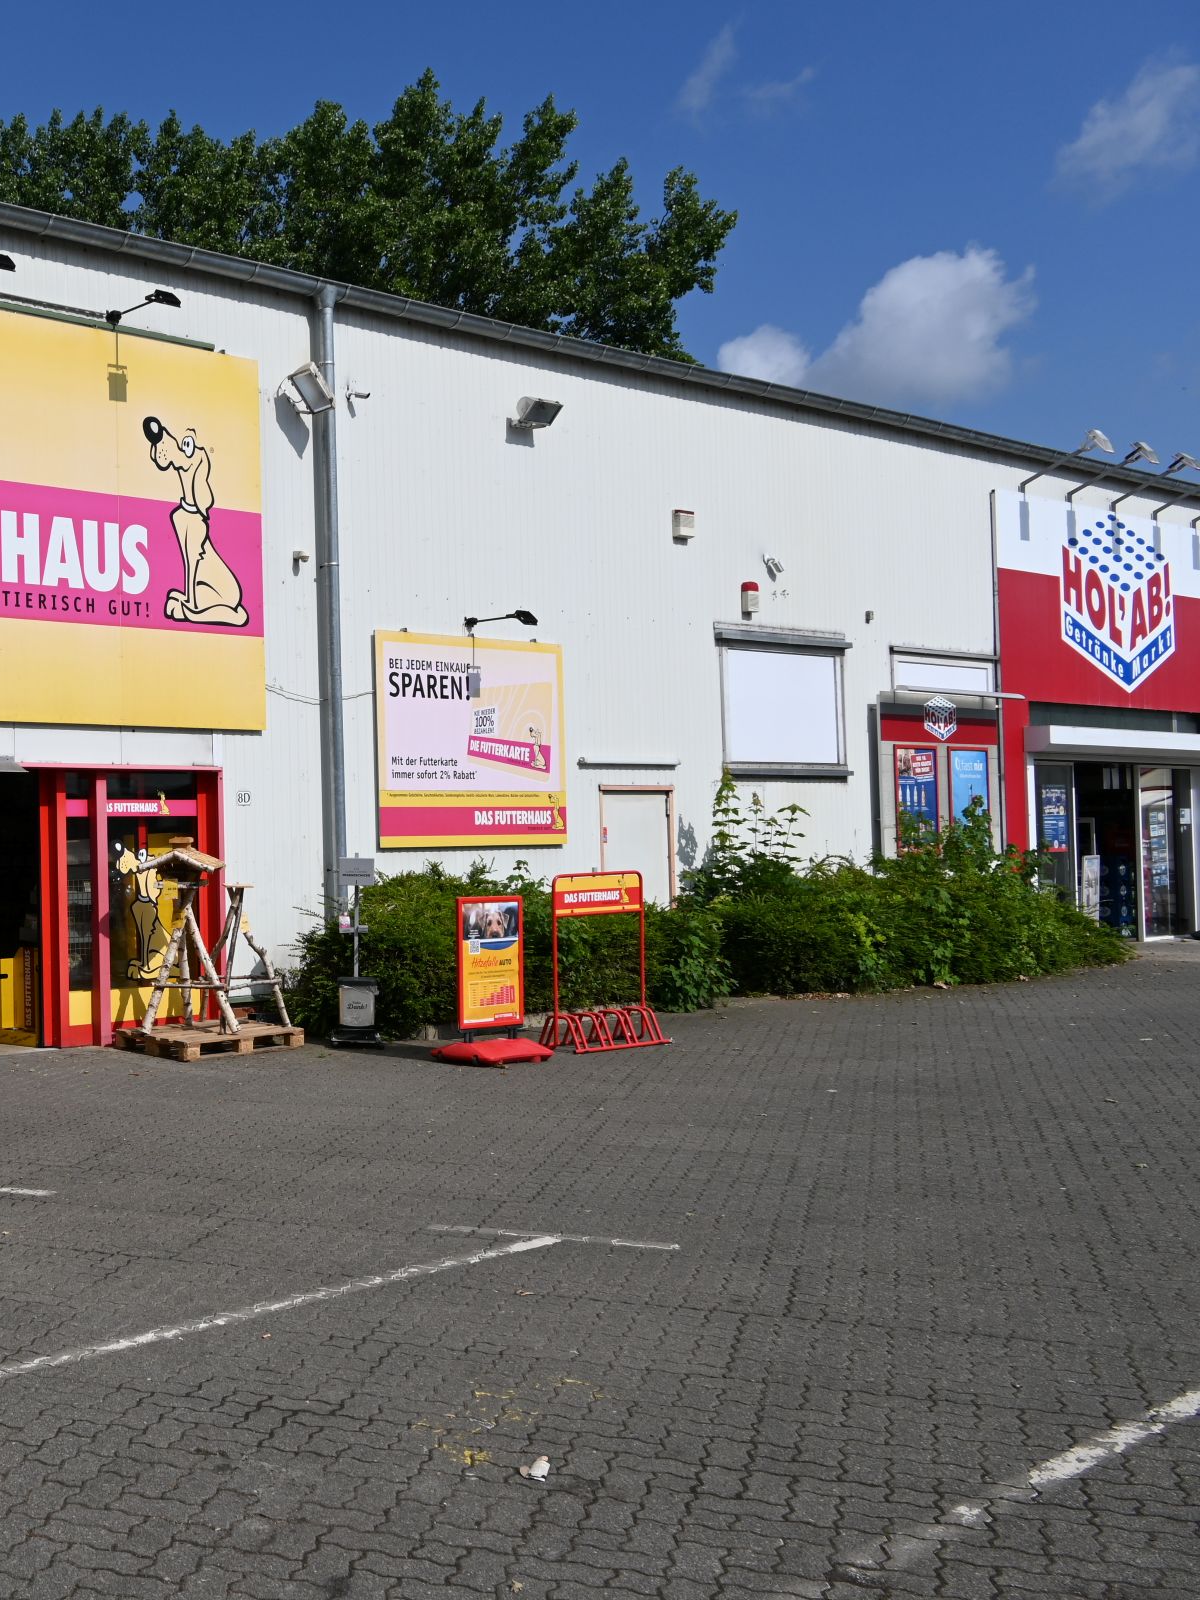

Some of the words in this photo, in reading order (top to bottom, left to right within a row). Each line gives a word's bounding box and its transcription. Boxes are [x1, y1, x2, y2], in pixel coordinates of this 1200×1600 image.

[2, 590, 95, 613] TIERISCH
[108, 599, 150, 618] GUT!
[1065, 615, 1125, 678] Getränke
[1132, 630, 1171, 679] Markt
[389, 658, 403, 669] BEI
[406, 659, 432, 671] JEDEM
[436, 661, 471, 674] EINKAUF
[389, 672, 471, 701] SPAREN!
[475, 715, 494, 728] 100%
[470, 739, 480, 752] DIE
[480, 741, 530, 762] FUTTERKARTE
[391, 756, 404, 766] Mit
[406, 756, 417, 766] der
[419, 756, 458, 767] Futterkarte
[392, 769, 414, 779] immer
[417, 769, 438, 780] sofort
[440, 770, 451, 780] 2%
[237, 792, 251, 804] 8D
[113, 802, 158, 813] FUTTERHAUS
[474, 810, 493, 825] DAS
[494, 810, 552, 825] FUTTERHAUS
[564, 892, 578, 904] DAS
[578, 890, 620, 903] FUTTERHAUS
[24, 948, 32, 1007] FUTTERHAUS
